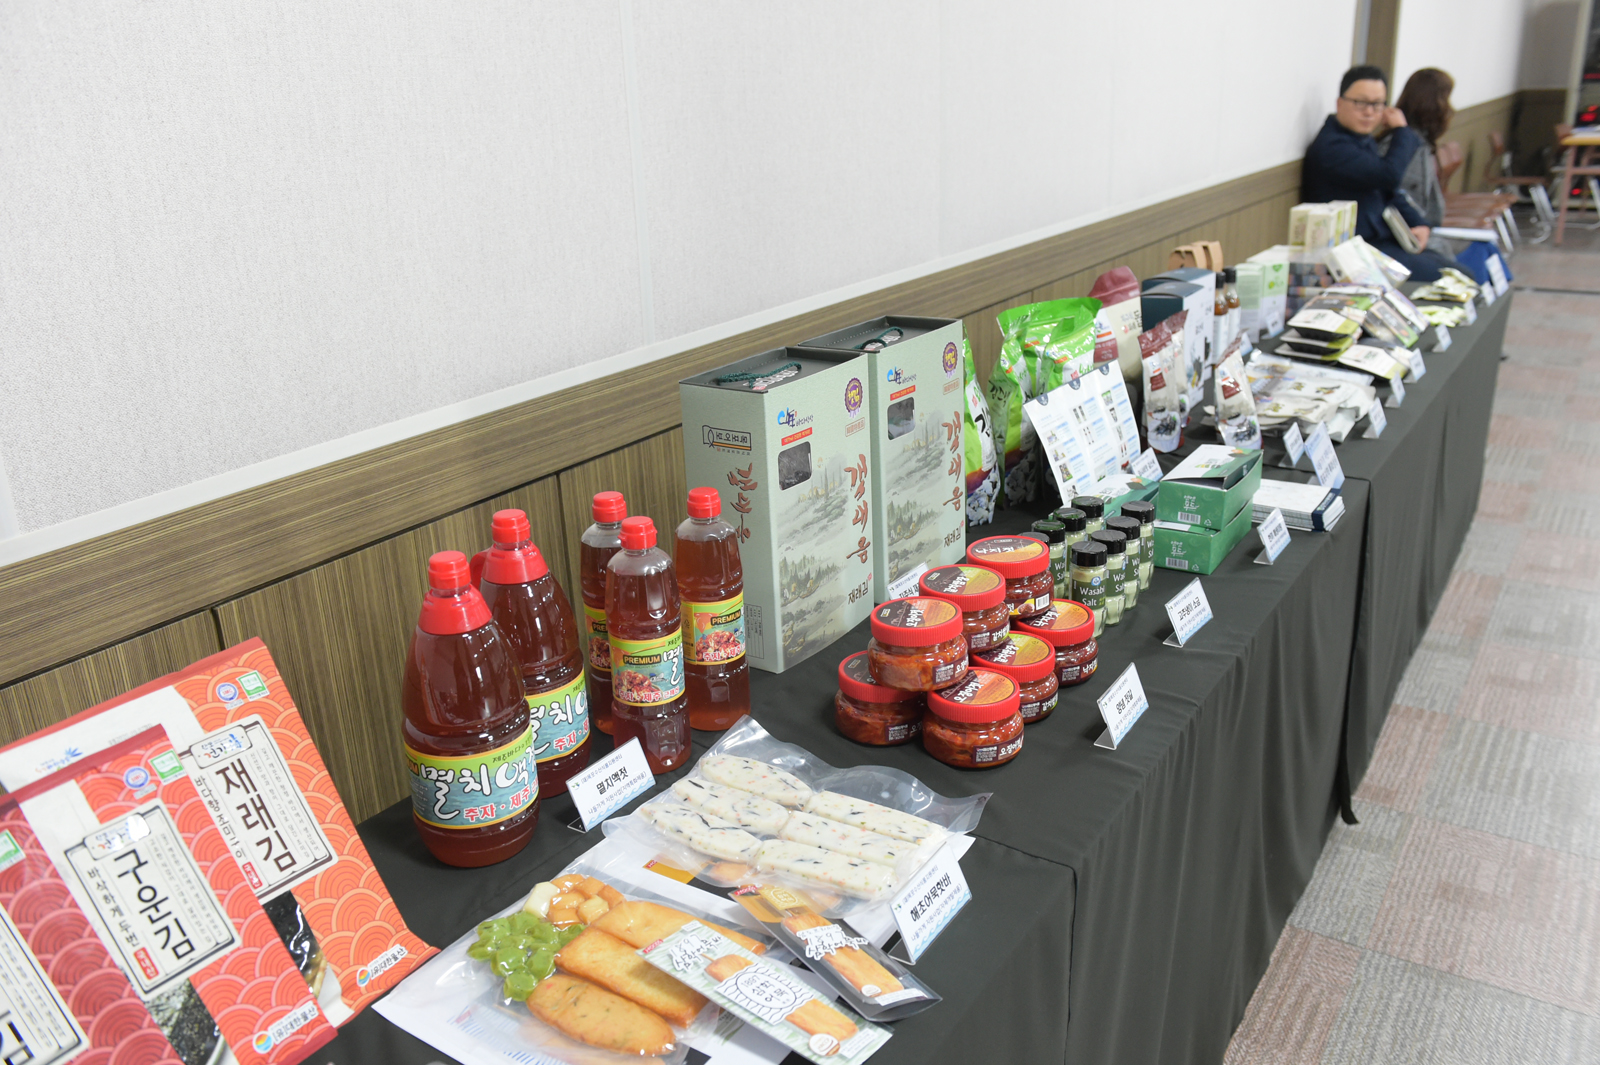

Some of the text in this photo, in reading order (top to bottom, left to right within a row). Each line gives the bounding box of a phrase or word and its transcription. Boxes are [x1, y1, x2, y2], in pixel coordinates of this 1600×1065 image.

[942, 411, 963, 511] 갯내음
[844, 454, 871, 563] 갯내음
[944, 527, 961, 547] 재래김
[848, 579, 868, 604] 재래김
[1080, 586, 1105, 596] Wasabi
[711, 610, 741, 625] PREMIUM
[624, 655, 661, 664] PREMIUM
[1116, 698, 1126, 714] 양념
[596, 766, 629, 795] 멸치액젓
[215, 758, 297, 872] 재래김
[87, 866, 124, 918] 바삭하게
[119, 920, 139, 947] 두번
[114, 848, 195, 960] 구운김
[910, 872, 952, 922] 해초어묵핫바
